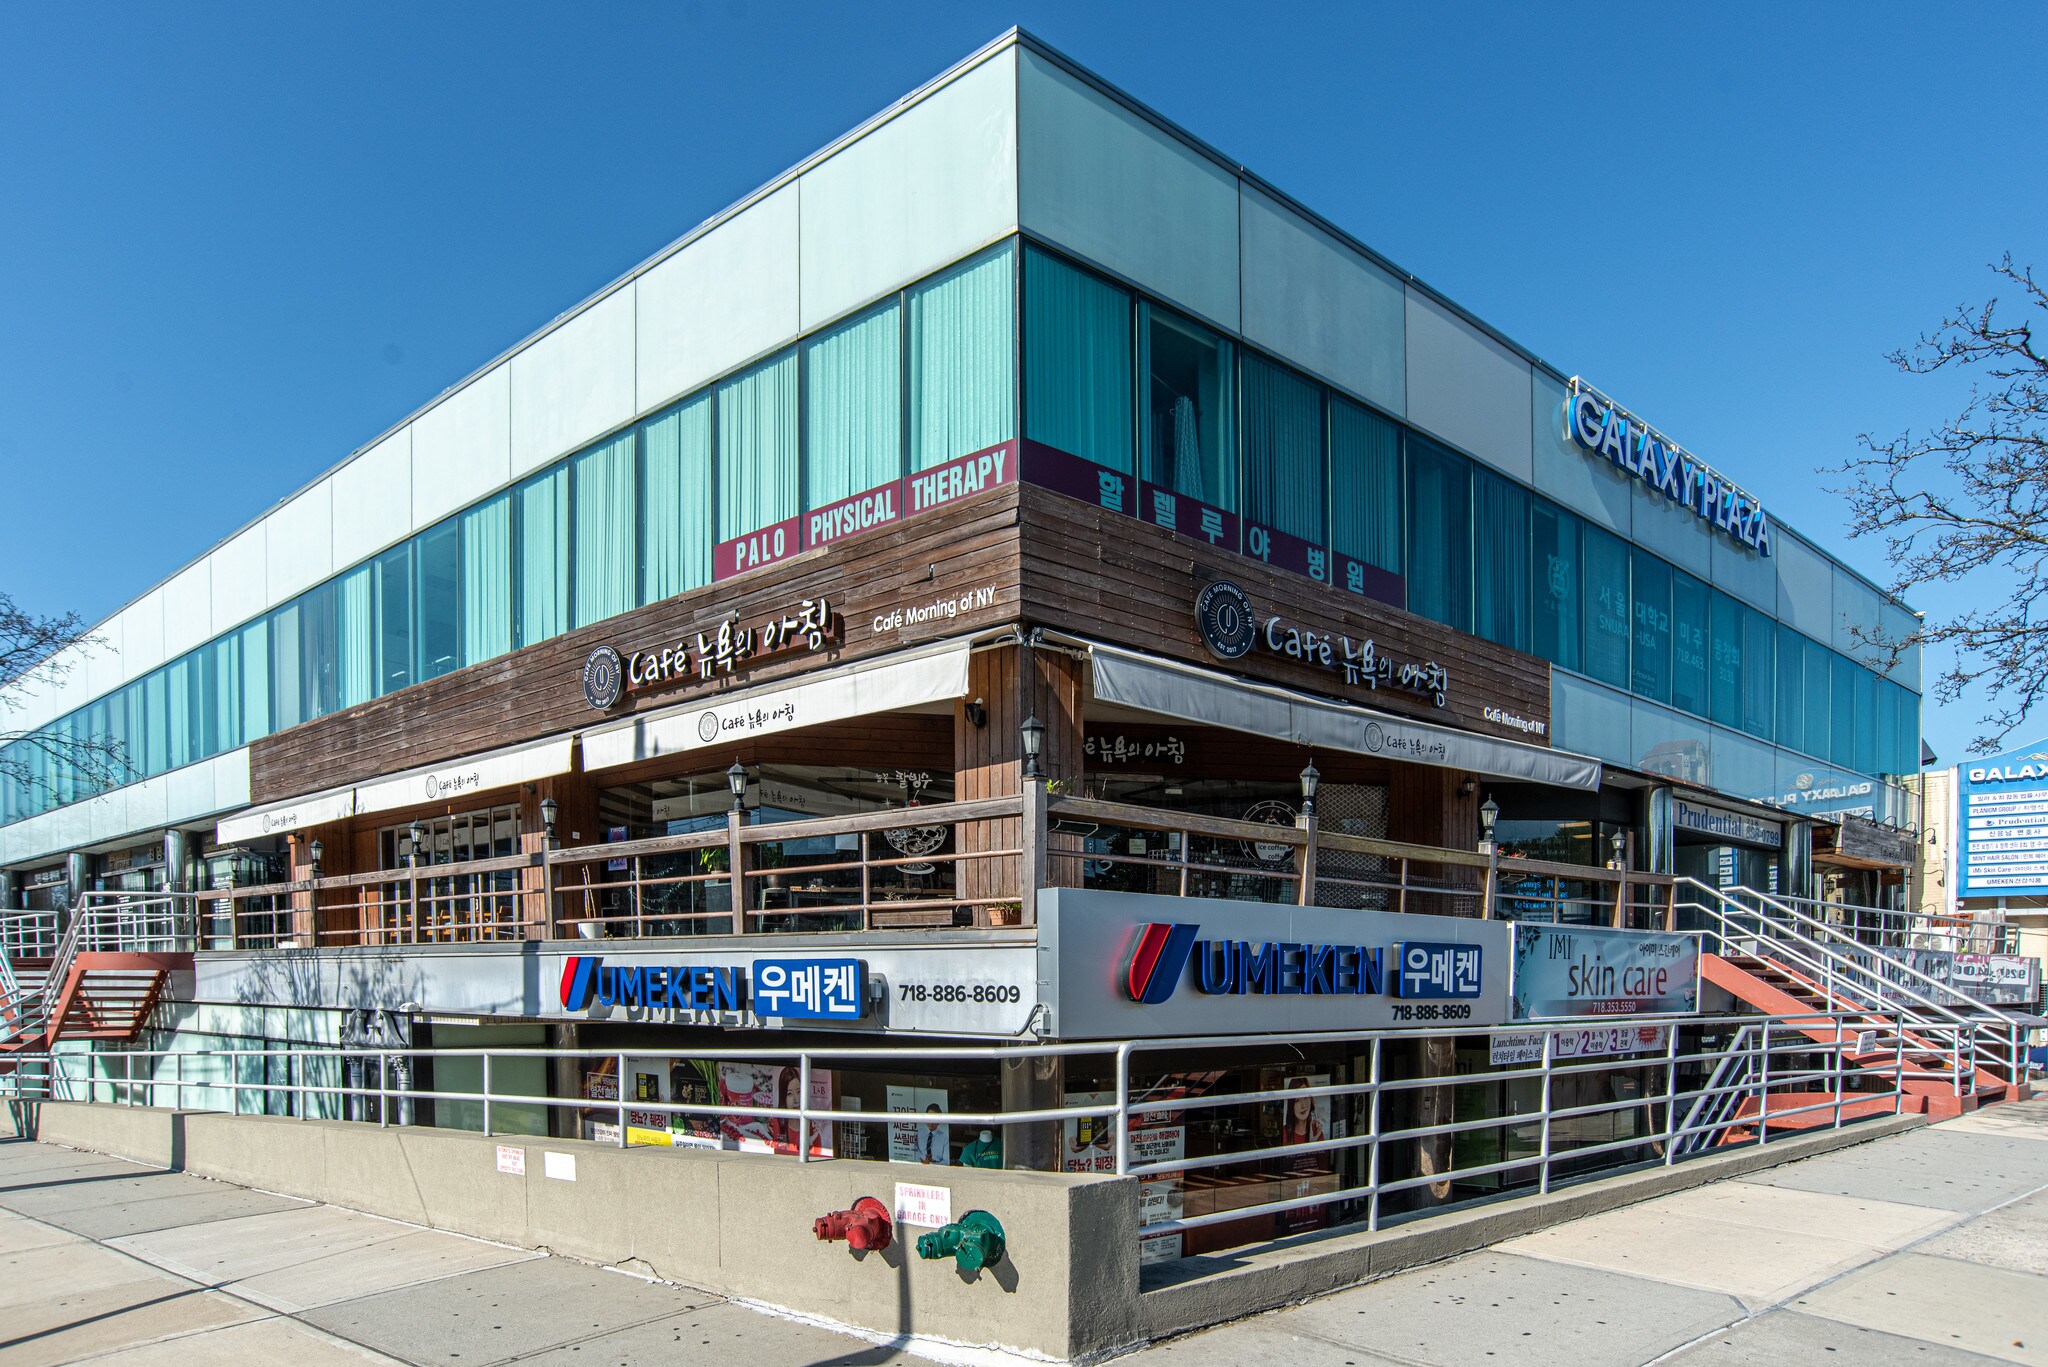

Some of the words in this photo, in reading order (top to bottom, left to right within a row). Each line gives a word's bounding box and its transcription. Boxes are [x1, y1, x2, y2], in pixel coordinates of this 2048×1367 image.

[1570, 391, 1696, 508] GALAXY
[1698, 471, 1771, 558] PLAZA
[736, 528, 785, 571] PALO
[811, 489, 895, 546] PHYSICAL
[912, 449, 1006, 511] THERAPY
[873, 608, 903, 633] Café
[906, 599, 957, 626] Morning
[960, 591, 974, 611] of
[976, 585, 996, 607] NY
[1202, 590, 1214, 612] CAFE
[1212, 584, 1243, 600] MORNING
[1243, 601, 1251, 613] OF
[630, 642, 689, 684] Café
[697, 619, 756, 679] 뉴욕의
[764, 598, 830, 650] 아침
[1264, 615, 1332, 666] Café
[1337, 635, 1393, 690] 뉴욕의
[1397, 660, 1449, 708] 아침
[721, 715, 745, 731] Café
[748, 708, 769, 730] 뉴욕의
[772, 703, 795, 722] 아침
[1484, 706, 1502, 723] Café
[1502, 711, 1528, 732] Morning
[1535, 721, 1545, 735] NY
[1100, 735, 1140, 764] 뉴욕의
[1144, 736, 1185, 764] 아침
[1386, 735, 1407, 750] Café
[1678, 801, 1742, 837] Prudential
[1998, 816, 2046, 825] Prudential
[1268, 843, 1287, 851] coffee
[1196, 939, 1384, 996] UMEKEN
[1404, 947, 1479, 994] 우메켄
[1567, 953, 1615, 997] skin
[1623, 965, 1668, 997] care
[598, 966, 740, 1011] UMEKEN
[758, 964, 856, 1014] 우메켄
[899, 983, 1021, 1005] 718-886-8609
[1391, 1004, 1471, 1022] 718-886-8609
[1592, 1000, 1637, 1014] 718.353.5550
[1492, 1035, 1527, 1049] Lunchtime
[1581, 1030, 1590, 1054] 2
[1609, 1028, 1618, 1051] 3
[899, 1186, 945, 1201] SPRINKLERS
[918, 1200, 927, 1211] IN
[896, 1209, 927, 1223] GARAGE
[929, 1213, 949, 1225] ONLY
